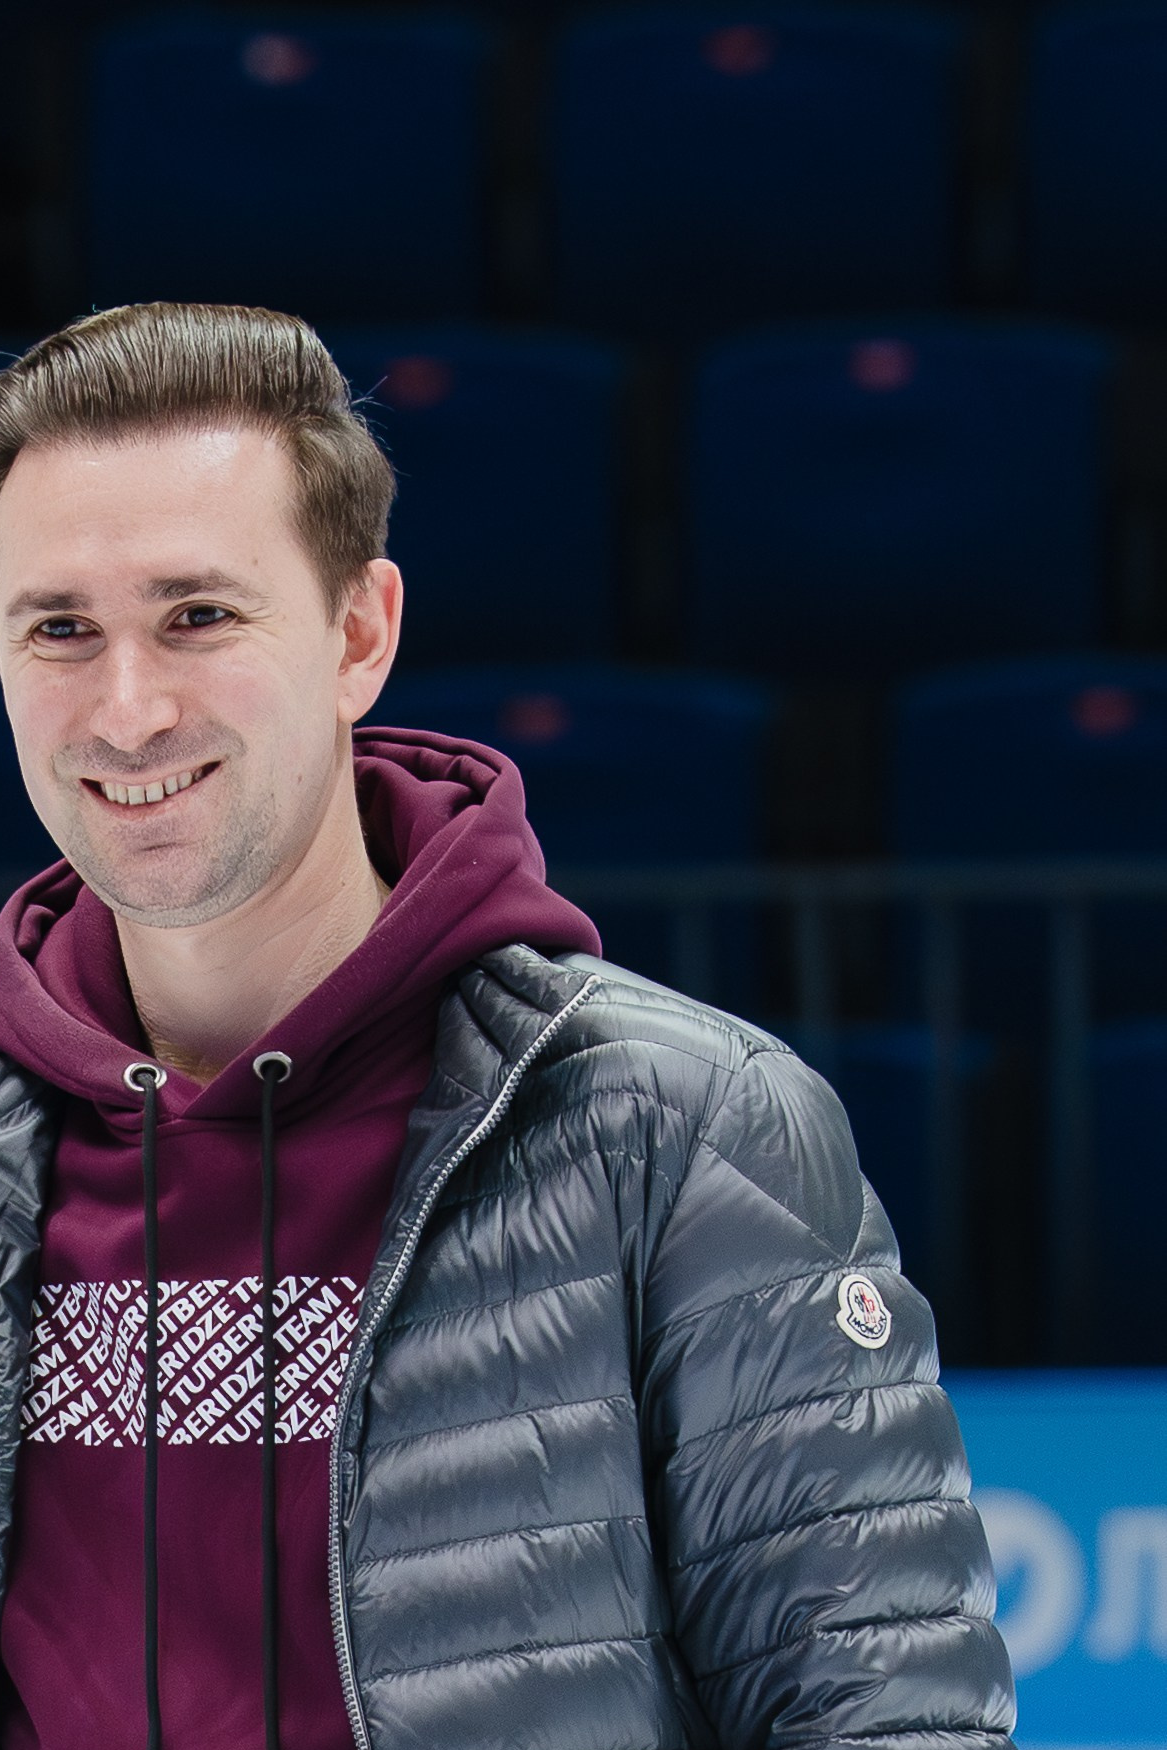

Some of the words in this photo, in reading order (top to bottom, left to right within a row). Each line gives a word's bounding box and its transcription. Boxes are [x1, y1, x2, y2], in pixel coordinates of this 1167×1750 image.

[77, 1308, 115, 1374] TEAM
[272, 1285, 342, 1353] TEAM
[107, 1353, 145, 1421] TEAM
[312, 1341, 353, 1396] TEA
[27, 1390, 99, 1443] TEAM
